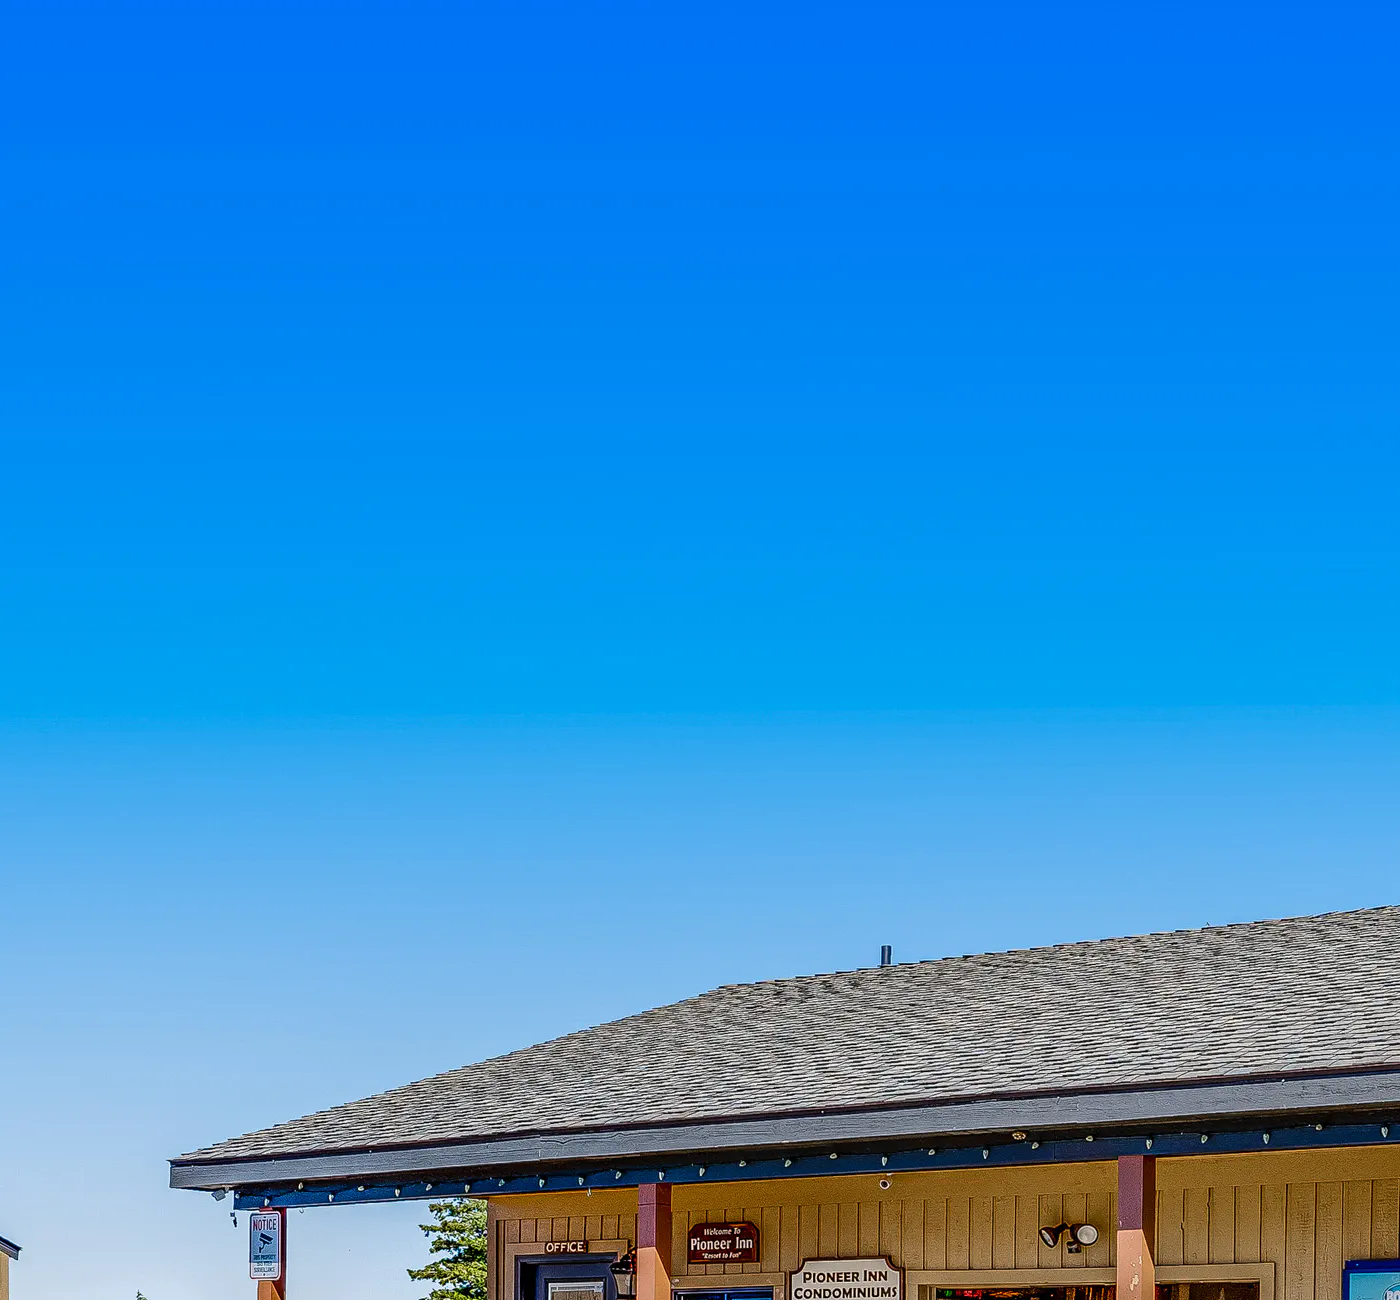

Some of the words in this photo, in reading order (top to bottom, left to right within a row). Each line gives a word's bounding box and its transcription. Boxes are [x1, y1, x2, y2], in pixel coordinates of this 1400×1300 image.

[252, 1218, 277, 1231] NOTICE
[703, 1227, 732, 1236] Welcome
[733, 1227, 741, 1235] To
[546, 1241, 584, 1253] OFFICE
[690, 1237, 732, 1251] Pioneer
[735, 1236, 753, 1249] Inn
[803, 1271, 860, 1284] PIONEER
[863, 1269, 888, 1282] INN
[793, 1286, 898, 1300] CONDOMINIUMS
